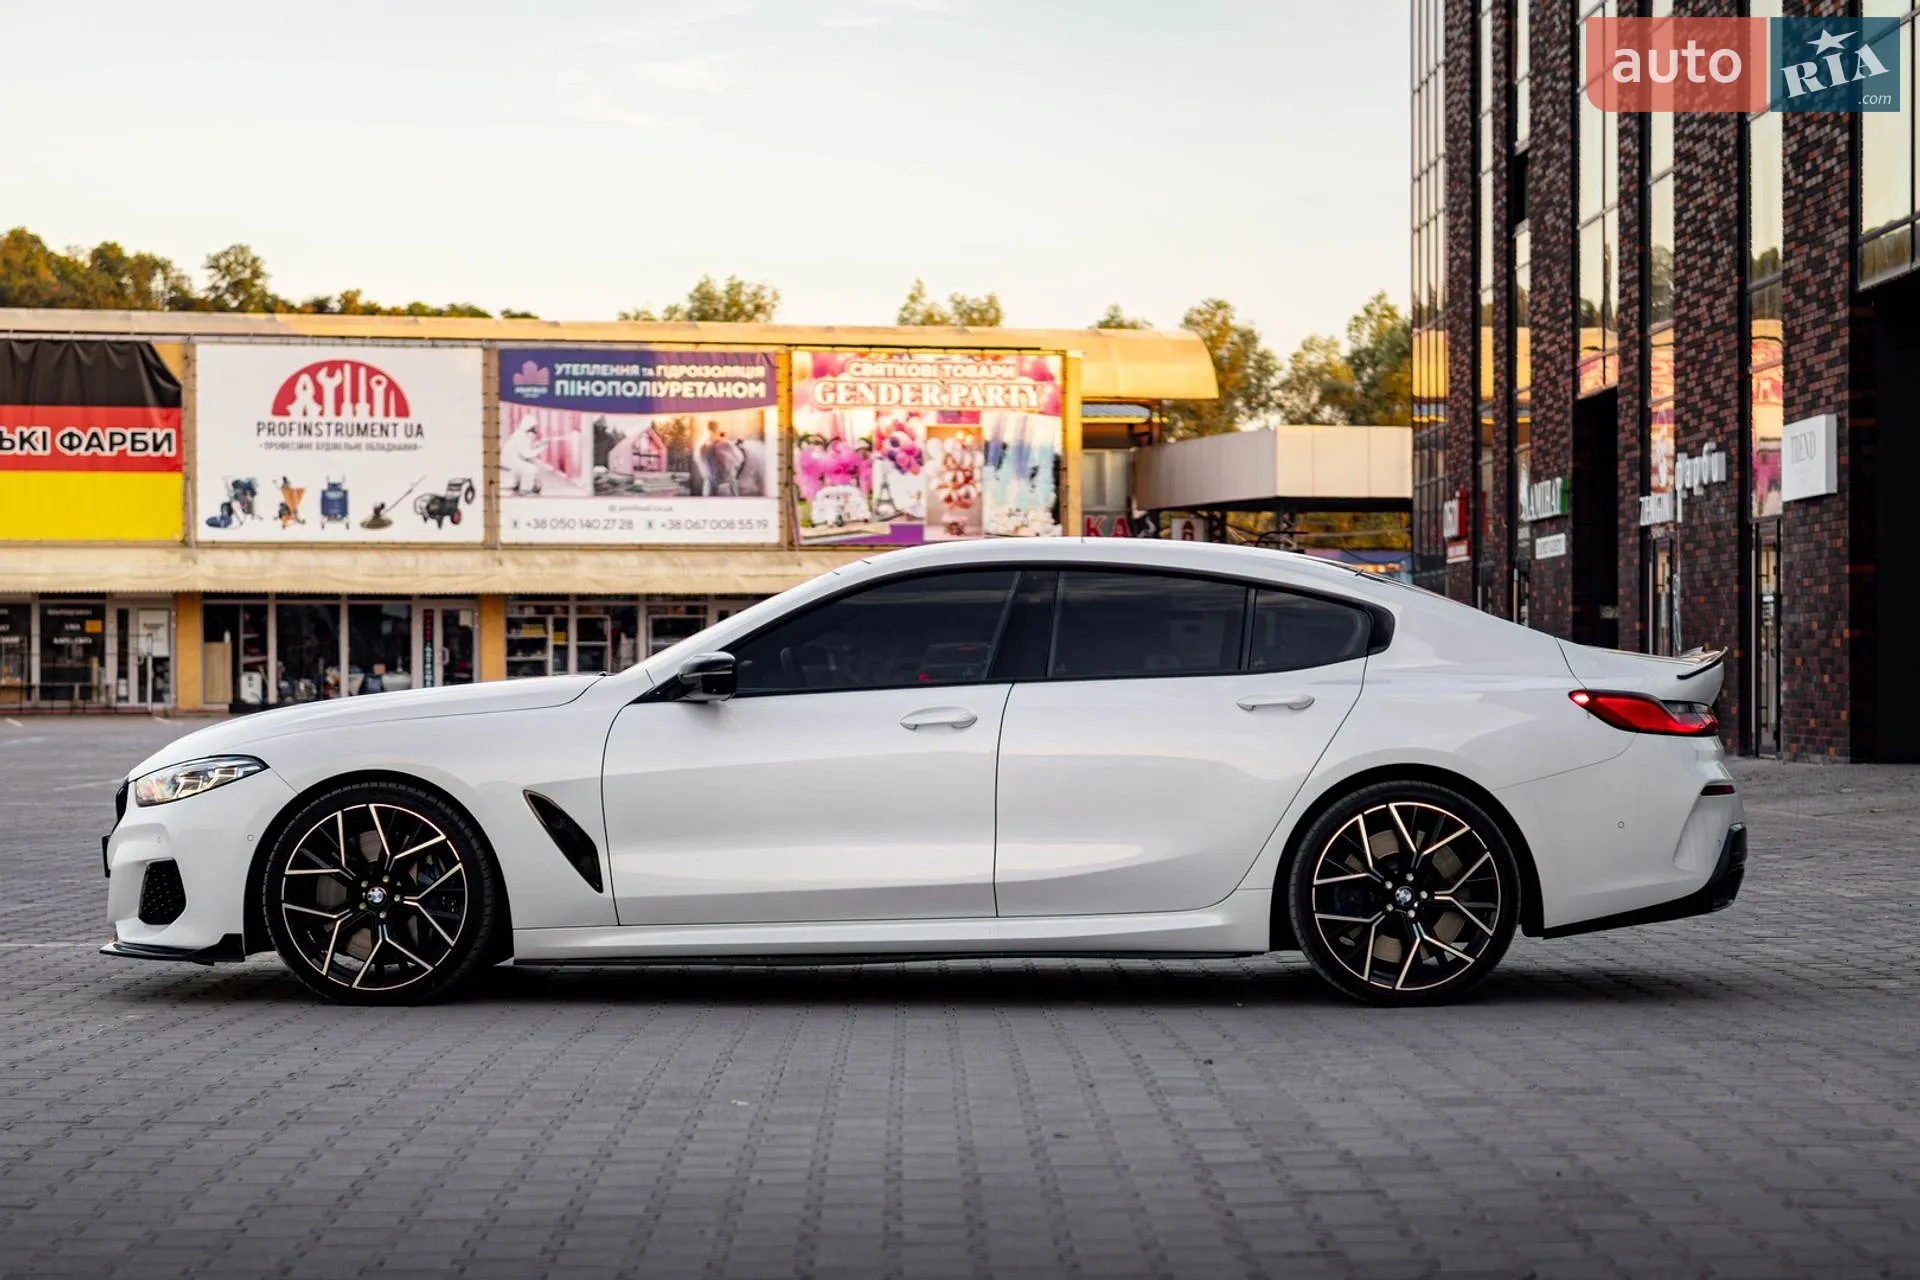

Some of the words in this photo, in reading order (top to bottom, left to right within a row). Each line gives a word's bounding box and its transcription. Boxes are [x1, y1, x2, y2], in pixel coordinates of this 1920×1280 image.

[554, 379, 766, 399] ПІНОПОЛІУРЕТАНОМ
[256, 421, 400, 438] PROFINSTRUMENT
[404, 423, 425, 439] UA
[58, 430, 173, 454] ФАРБИ
